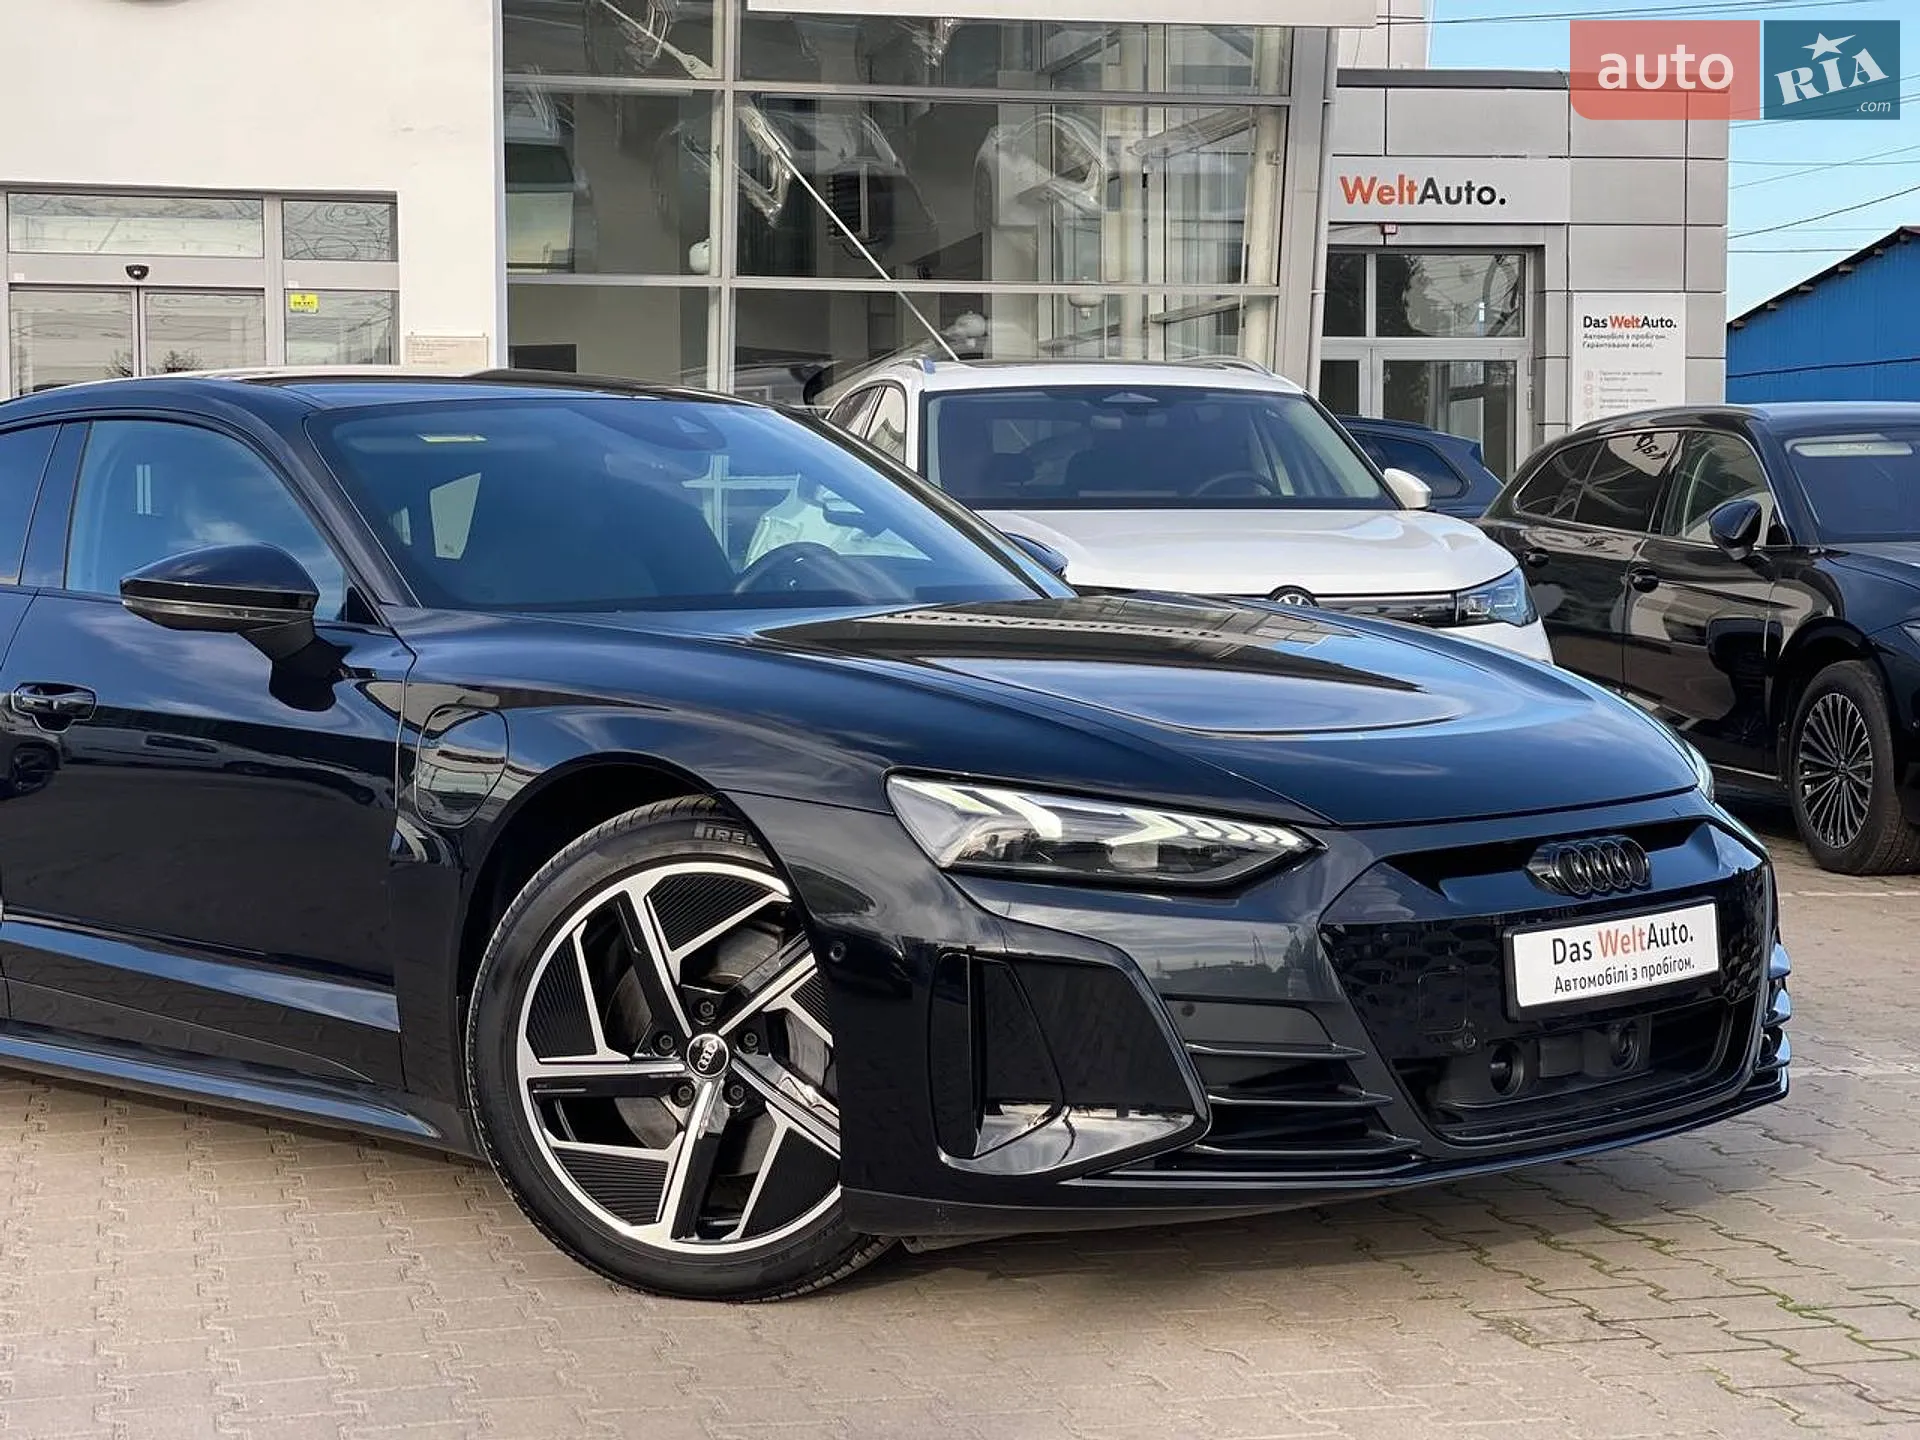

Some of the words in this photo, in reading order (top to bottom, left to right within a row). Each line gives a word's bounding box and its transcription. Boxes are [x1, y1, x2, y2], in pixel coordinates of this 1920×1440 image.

[1339, 174, 1507, 205] WeltAuto.
[1583, 315, 1608, 328] Das
[1609, 315, 1677, 328] WeltAuto.
[1552, 937, 1593, 965] Das
[1597, 922, 1694, 958] WeltAuto.
[1554, 964, 1629, 994] Автомобілі
[1631, 969, 1638, 980] з
[1641, 957, 1695, 983] пробігом.
